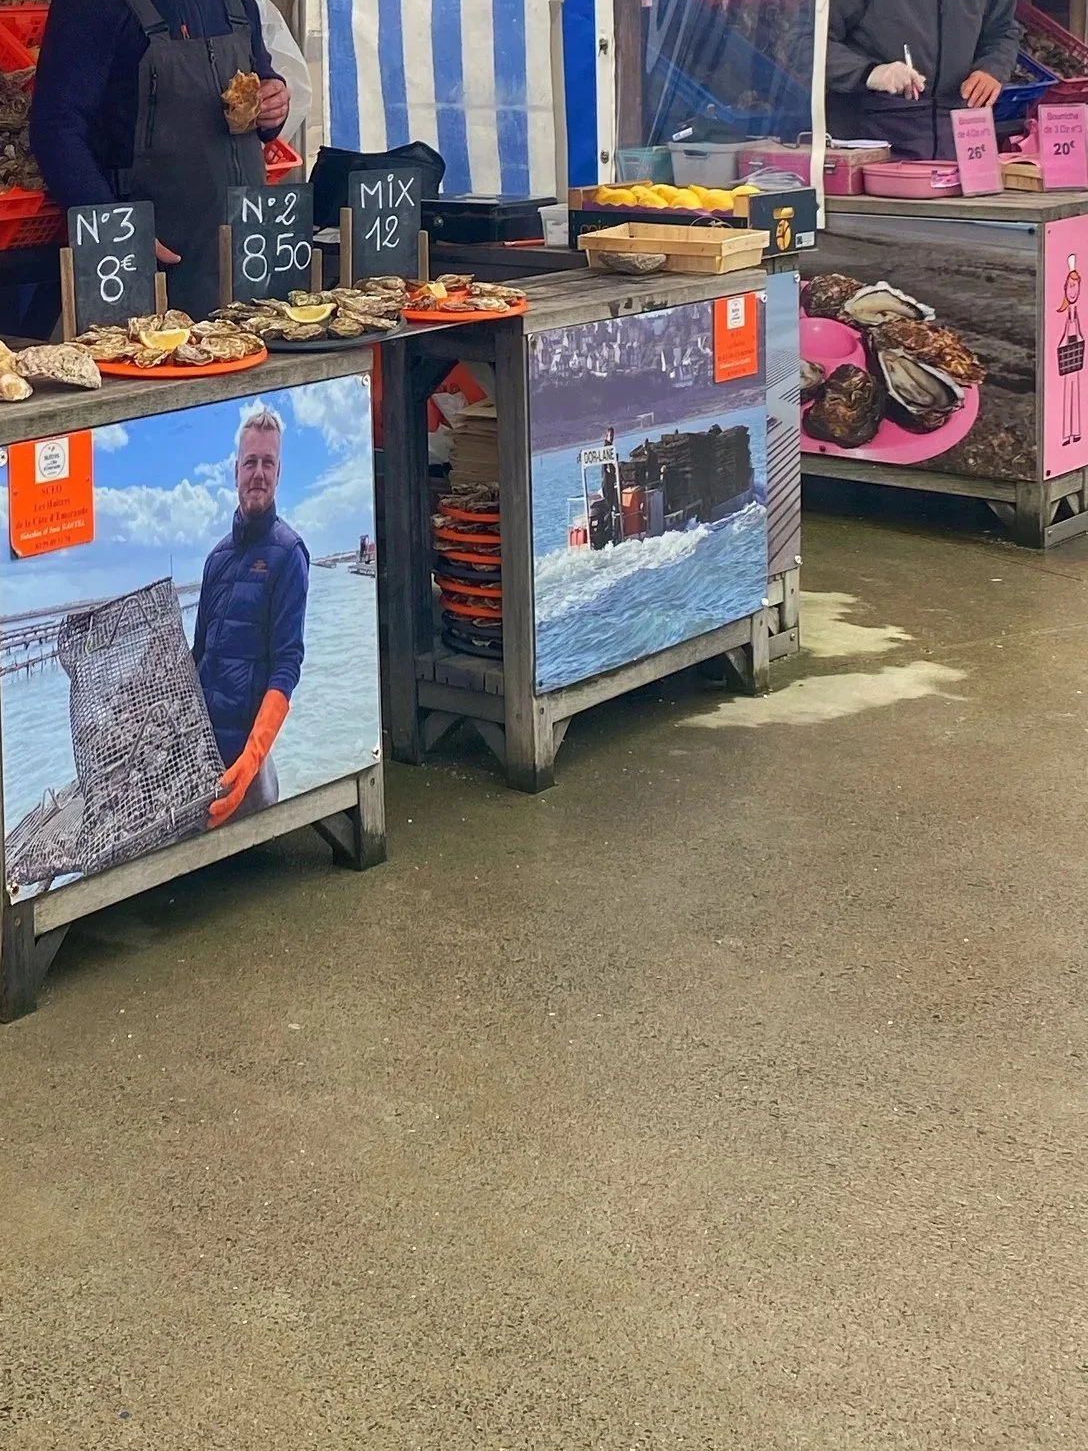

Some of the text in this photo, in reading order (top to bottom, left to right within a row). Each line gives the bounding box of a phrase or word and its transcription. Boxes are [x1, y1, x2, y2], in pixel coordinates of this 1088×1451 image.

[1053, 140, 1075, 156] 20€
[365, 215, 400, 251] 12
[96, 254, 137, 302] 8€
[242, 233, 312, 288] 8,50
